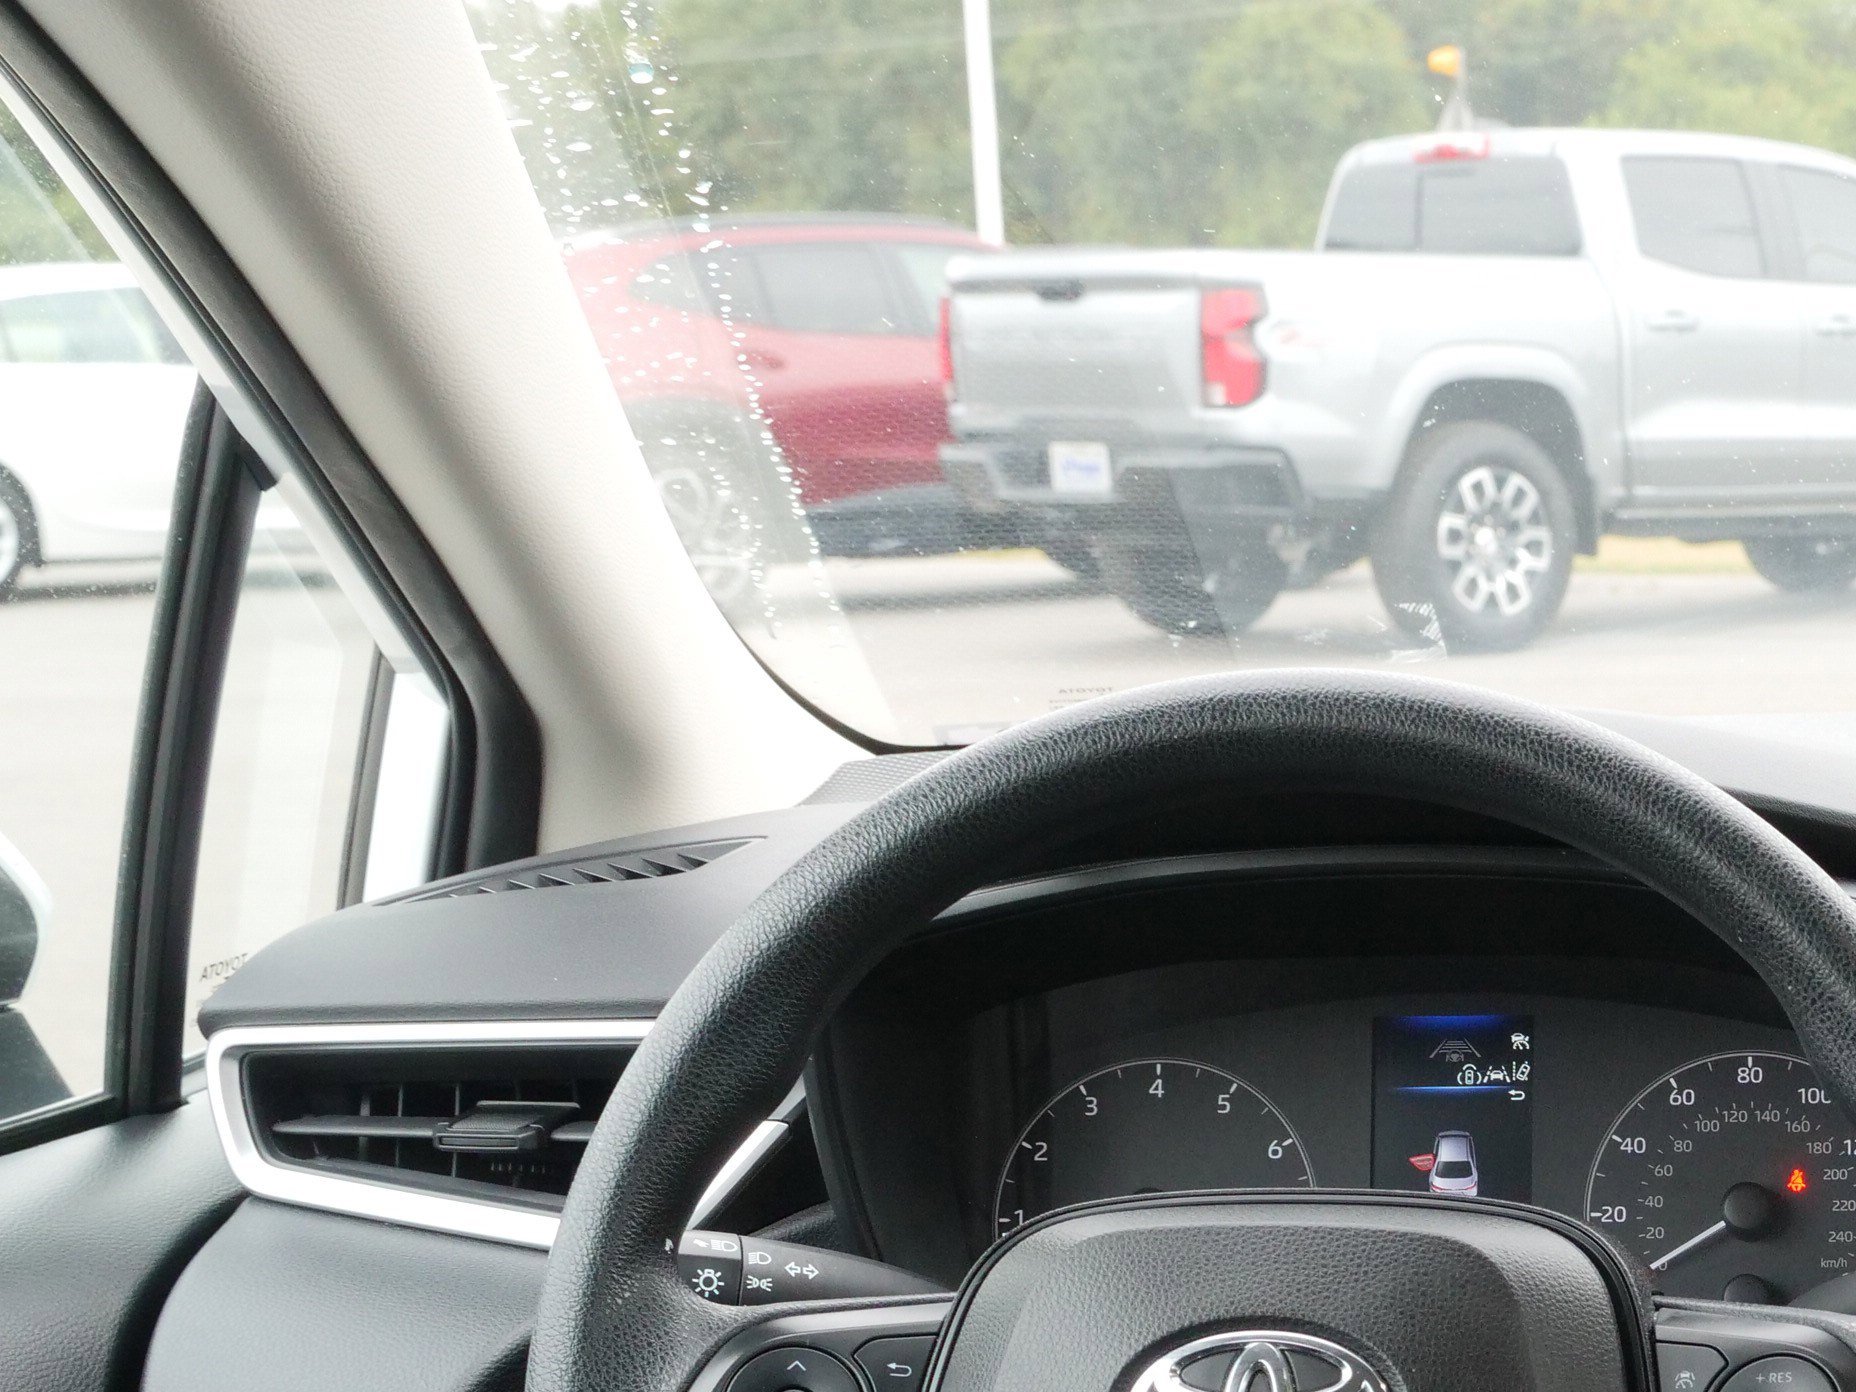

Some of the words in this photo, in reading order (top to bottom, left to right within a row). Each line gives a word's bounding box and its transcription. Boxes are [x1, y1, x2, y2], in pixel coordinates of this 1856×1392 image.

[1736, 1067, 1763, 1084] 80
[1149, 1078, 1165, 1098] 4
[1217, 1094, 1231, 1114] 5
[1669, 1089, 1696, 1106] 60
[1085, 1096, 1098, 1116] 3
[1722, 1110, 1748, 1123] 120
[1755, 1110, 1780, 1123] 140
[1694, 1120, 1720, 1133] 100
[1785, 1120, 1810, 1133] 160
[1033, 1142, 1048, 1161] 2
[1268, 1140, 1283, 1159] 6
[1620, 1137, 1646, 1154] 40
[1673, 1140, 1692, 1152] 80
[1806, 1141, 1832, 1154] 180
[1654, 1164, 1673, 1177] 60
[1823, 1168, 1848, 1181] 200
[1644, 1196, 1664, 1208] 40
[1832, 1199, 1856, 1212] 220
[1014, 1209, 1024, 1225] 1
[1601, 1206, 1627, 1223] 20
[1645, 1227, 1665, 1239] 20
[1828, 1230, 1853, 1243] 240
[1820, 1257, 1848, 1269] km/h
[1768, 1372, 1793, 1384] RES
